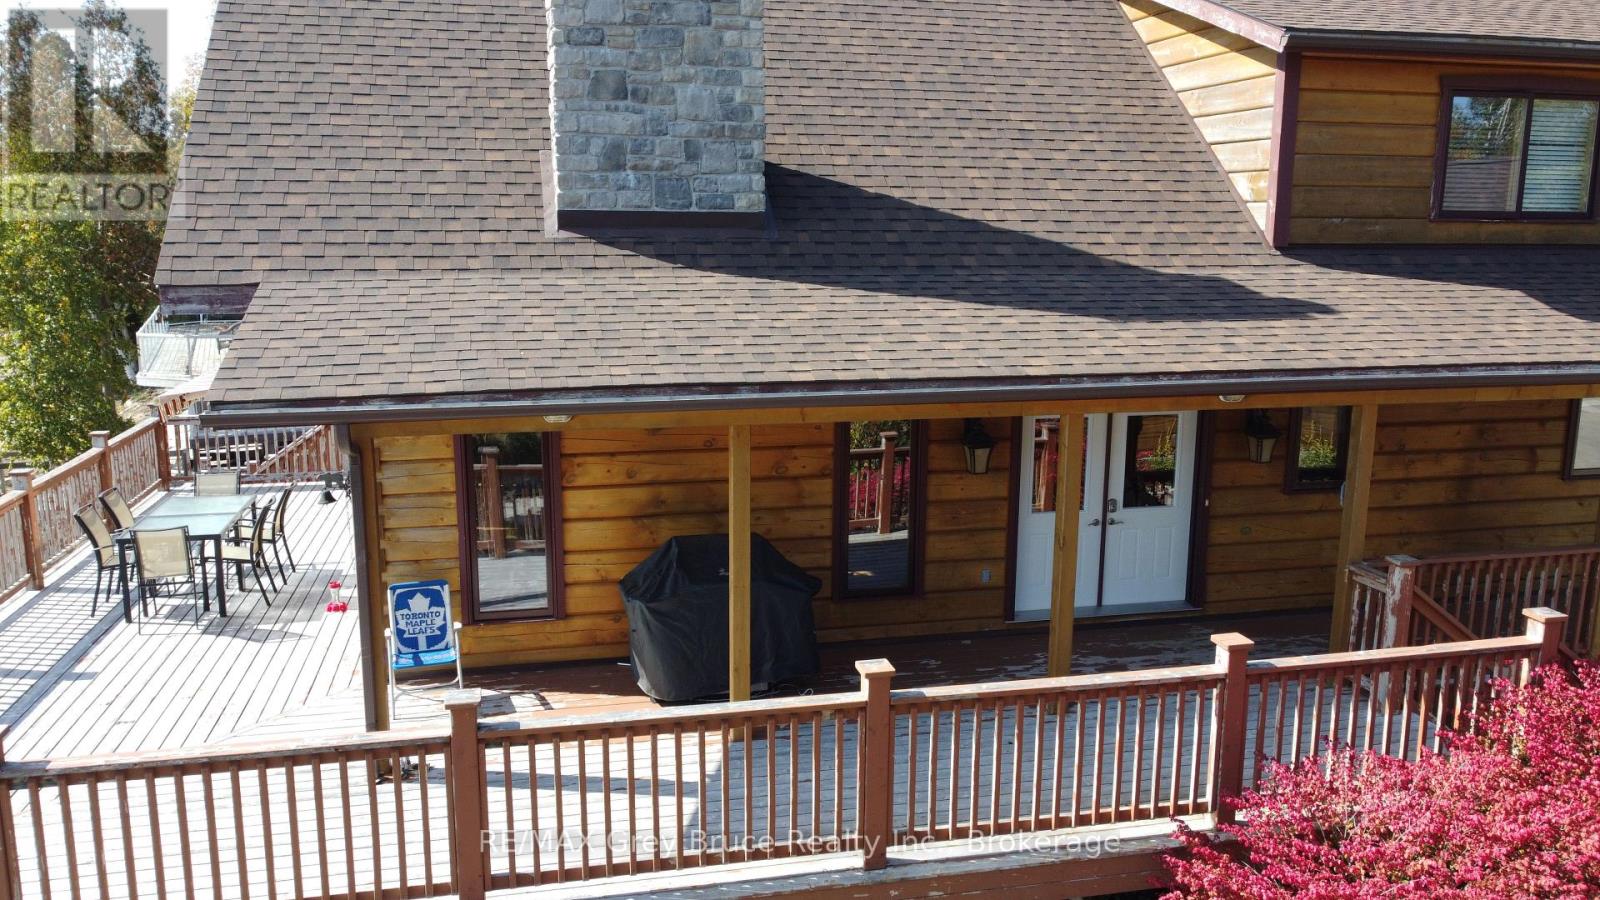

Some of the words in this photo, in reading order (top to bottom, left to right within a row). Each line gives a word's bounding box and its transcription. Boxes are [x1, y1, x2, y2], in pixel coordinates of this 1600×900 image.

[400, 611, 441, 620] TORONTO
[405, 619, 436, 627] MAPLE
[407, 627, 436, 635] LEAFS
